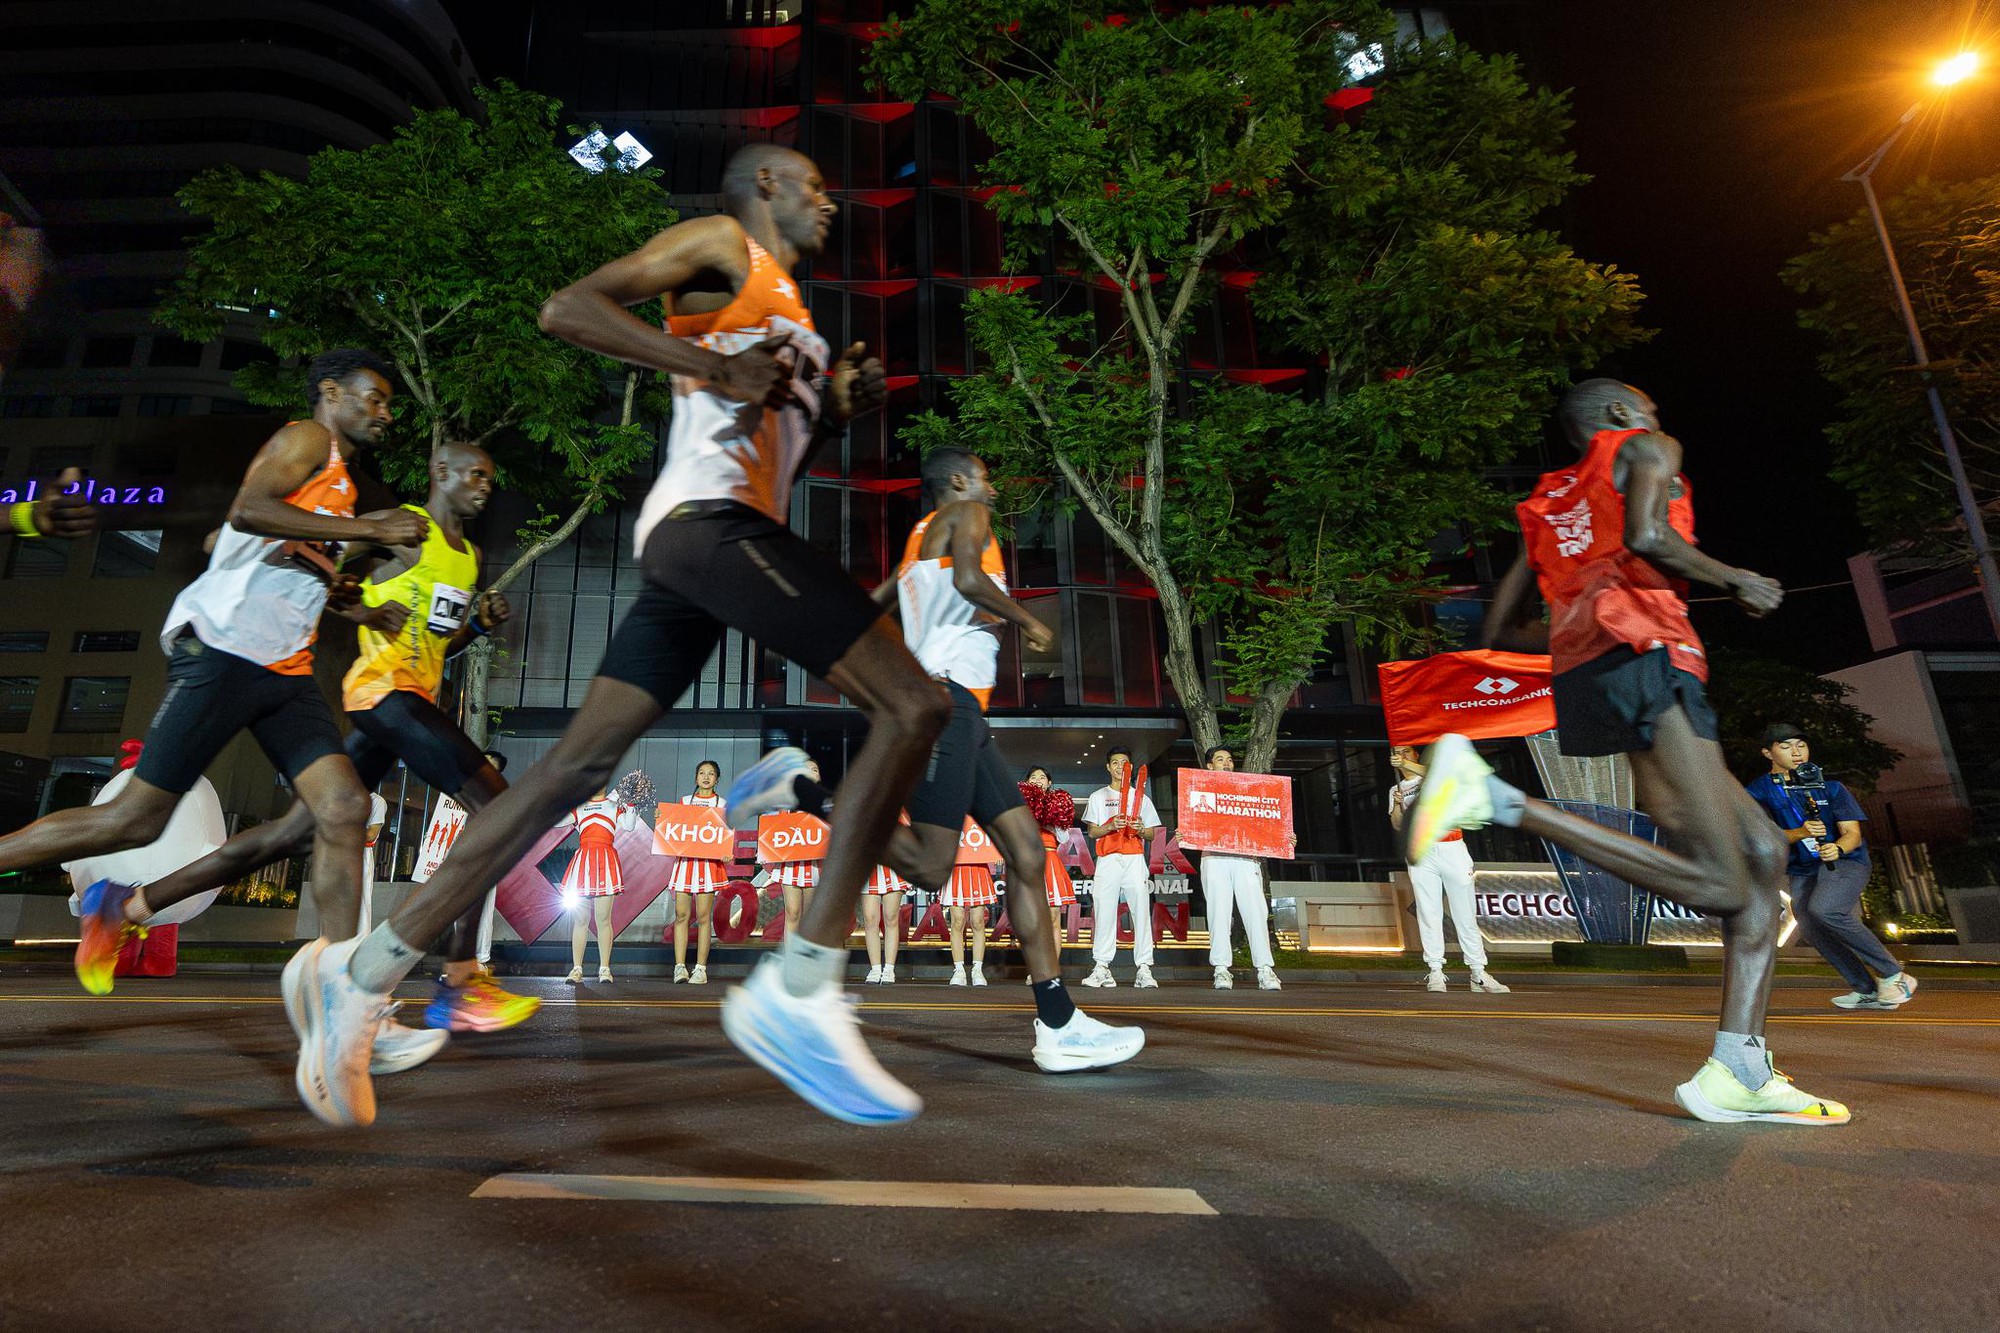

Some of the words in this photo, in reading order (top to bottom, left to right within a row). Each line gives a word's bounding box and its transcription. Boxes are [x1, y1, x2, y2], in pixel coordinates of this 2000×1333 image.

[1442, 686, 1552, 711] TECHCOMBANK
[1217, 800, 1280, 810] INTERNATIONAL
[1261, 796, 1280, 805] CITY
[1217, 805, 1280, 819] MARATHON
[664, 821, 724, 845] KHỞI
[772, 826, 823, 849] ĐẦU
